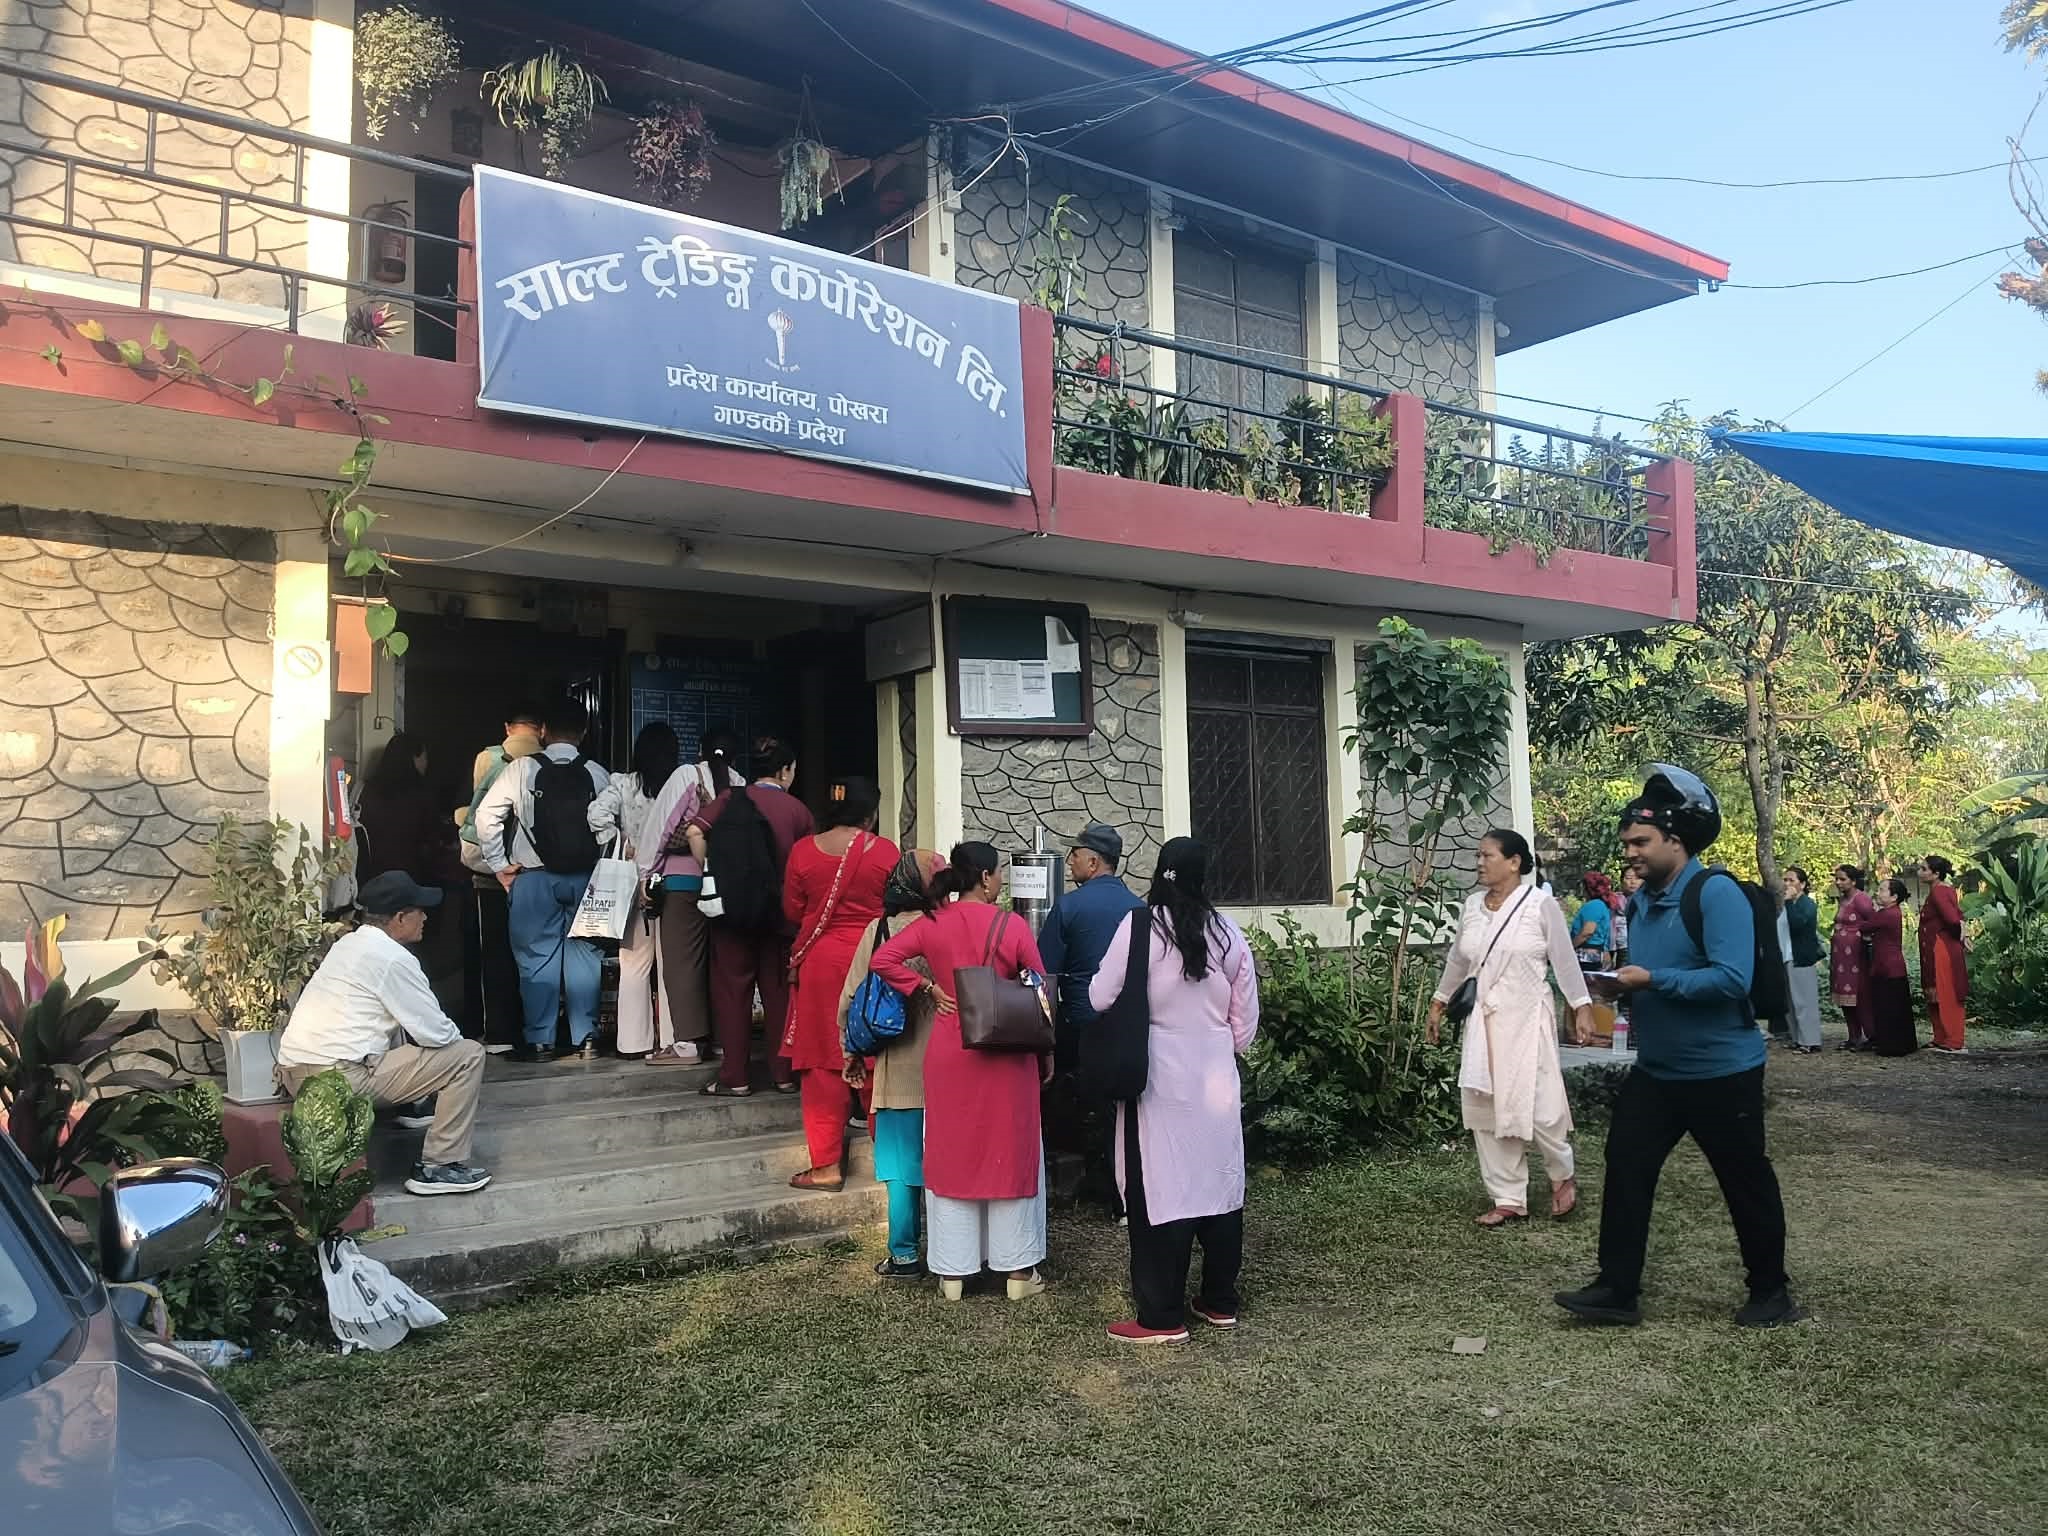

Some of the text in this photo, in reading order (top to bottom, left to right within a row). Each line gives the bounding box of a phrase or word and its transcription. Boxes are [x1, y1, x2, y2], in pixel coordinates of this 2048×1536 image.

[496, 234, 1007, 418] साल्ट ट्रेडिङ्ग कर्पोरेशन लि.
[665, 364, 719, 393] प्रदेश
[828, 392, 888, 425] पोखरा
[713, 405, 846, 446] गण्डकी प्रदेश
